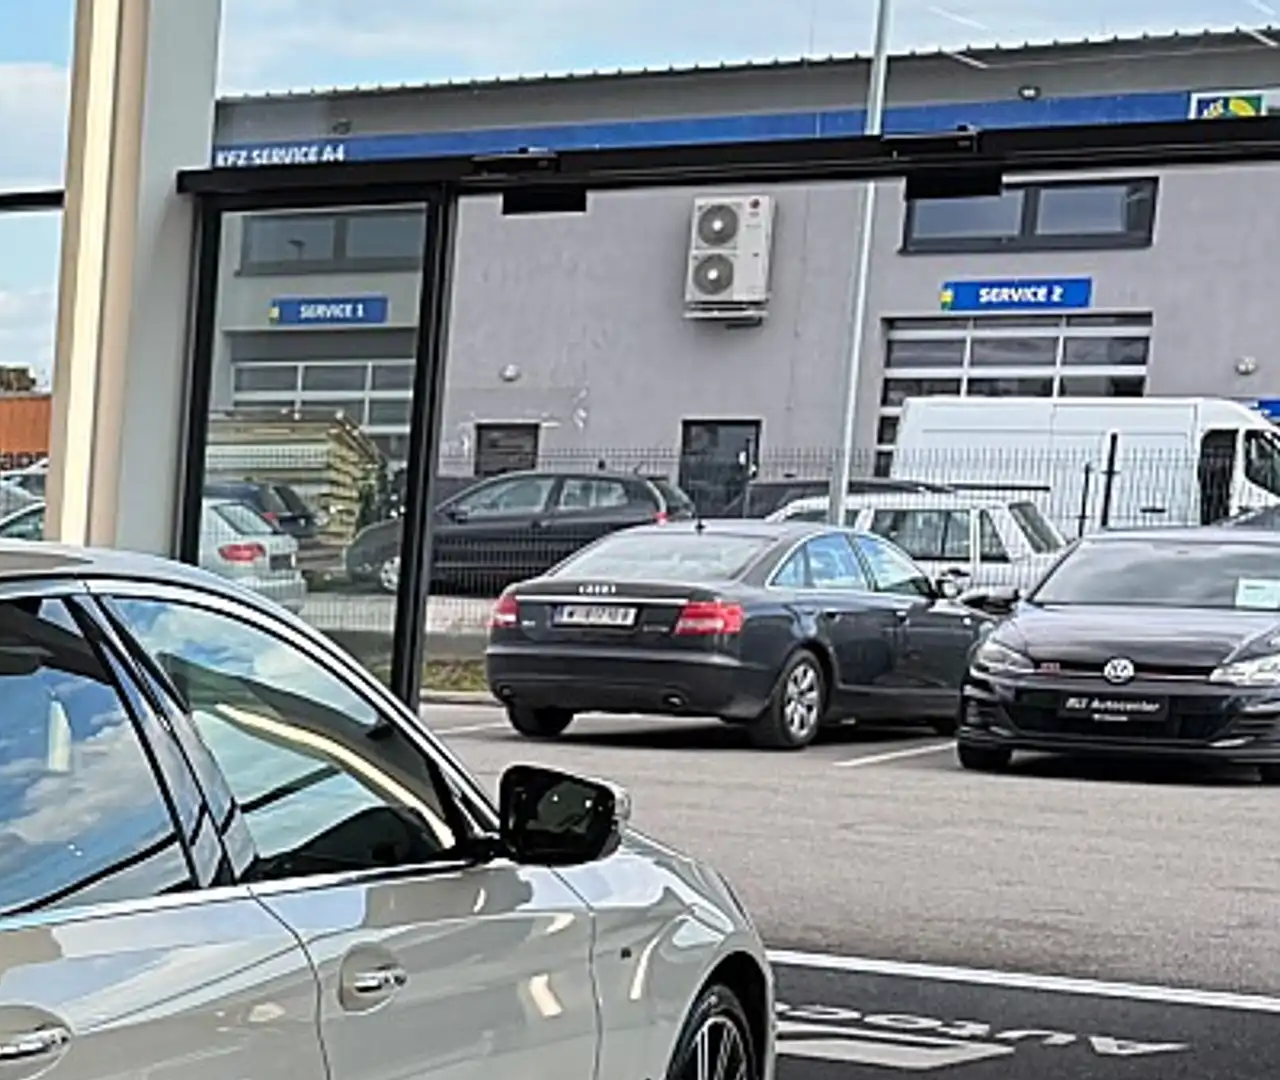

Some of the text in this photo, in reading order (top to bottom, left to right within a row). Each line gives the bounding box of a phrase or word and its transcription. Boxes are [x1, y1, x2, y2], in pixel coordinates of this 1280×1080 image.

[214, 143, 345, 167] KFZ SERVICE A4
[978, 284, 1064, 303] SERVICE 2
[299, 303, 365, 319] SERVICE 1
